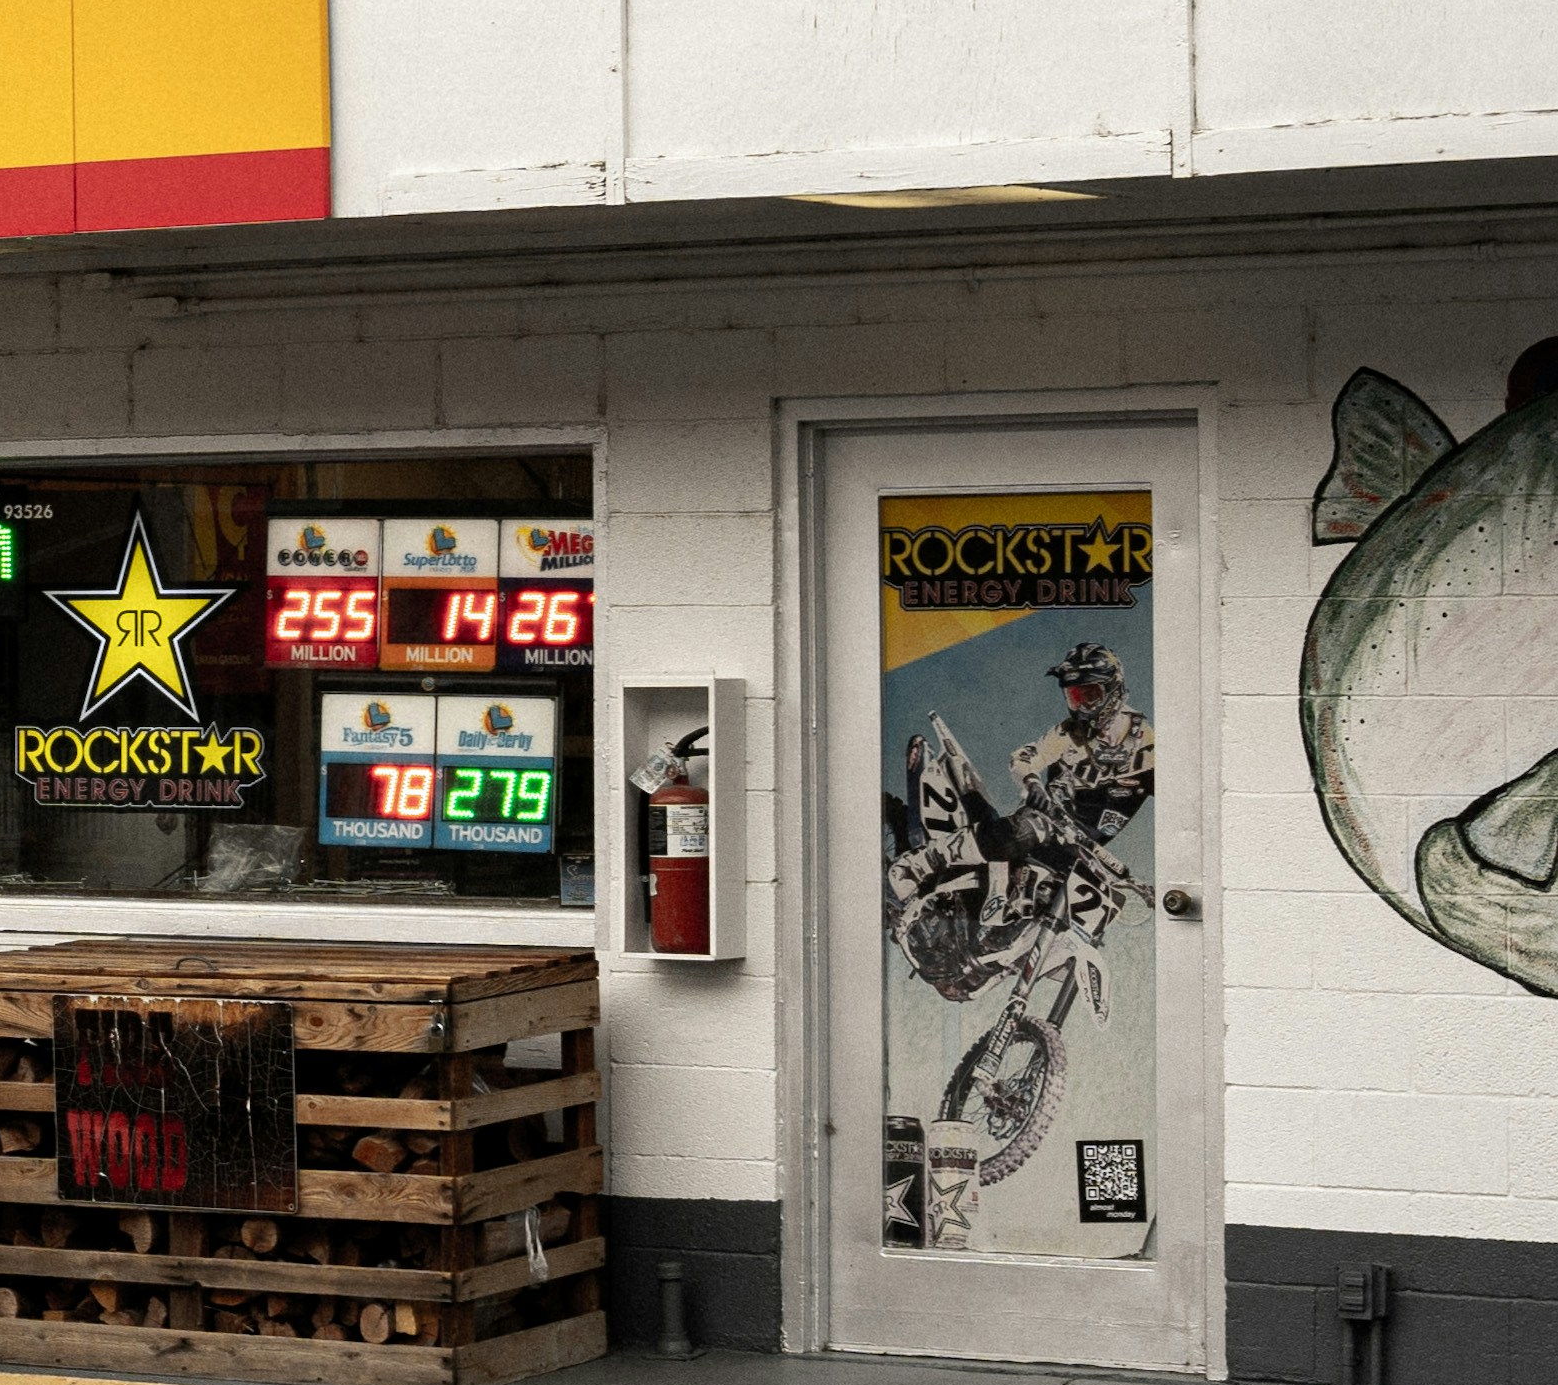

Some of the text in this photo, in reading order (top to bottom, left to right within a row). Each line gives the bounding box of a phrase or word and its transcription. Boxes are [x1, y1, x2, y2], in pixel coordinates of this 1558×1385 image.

[4, 504, 53, 520] 93526
[543, 530, 593, 557] MEG
[905, 578, 1131, 605] ENERGY DRINK
[276, 589, 376, 640] 255
[443, 593, 496, 641] 14
[291, 646, 356, 661] MILLION
[406, 647, 474, 663] MILLION
[342, 726, 413, 747] Fantasy 5
[458, 730, 487, 751] Daily
[37, 777, 240, 802] ENERGY DRINK
[372, 767, 433, 817] 78
[446, 768, 551, 821] 279
[333, 820, 423, 840] THOUSAND
[449, 824, 543, 844] THOUSAND
[66, 1110, 187, 1191] WOOD
